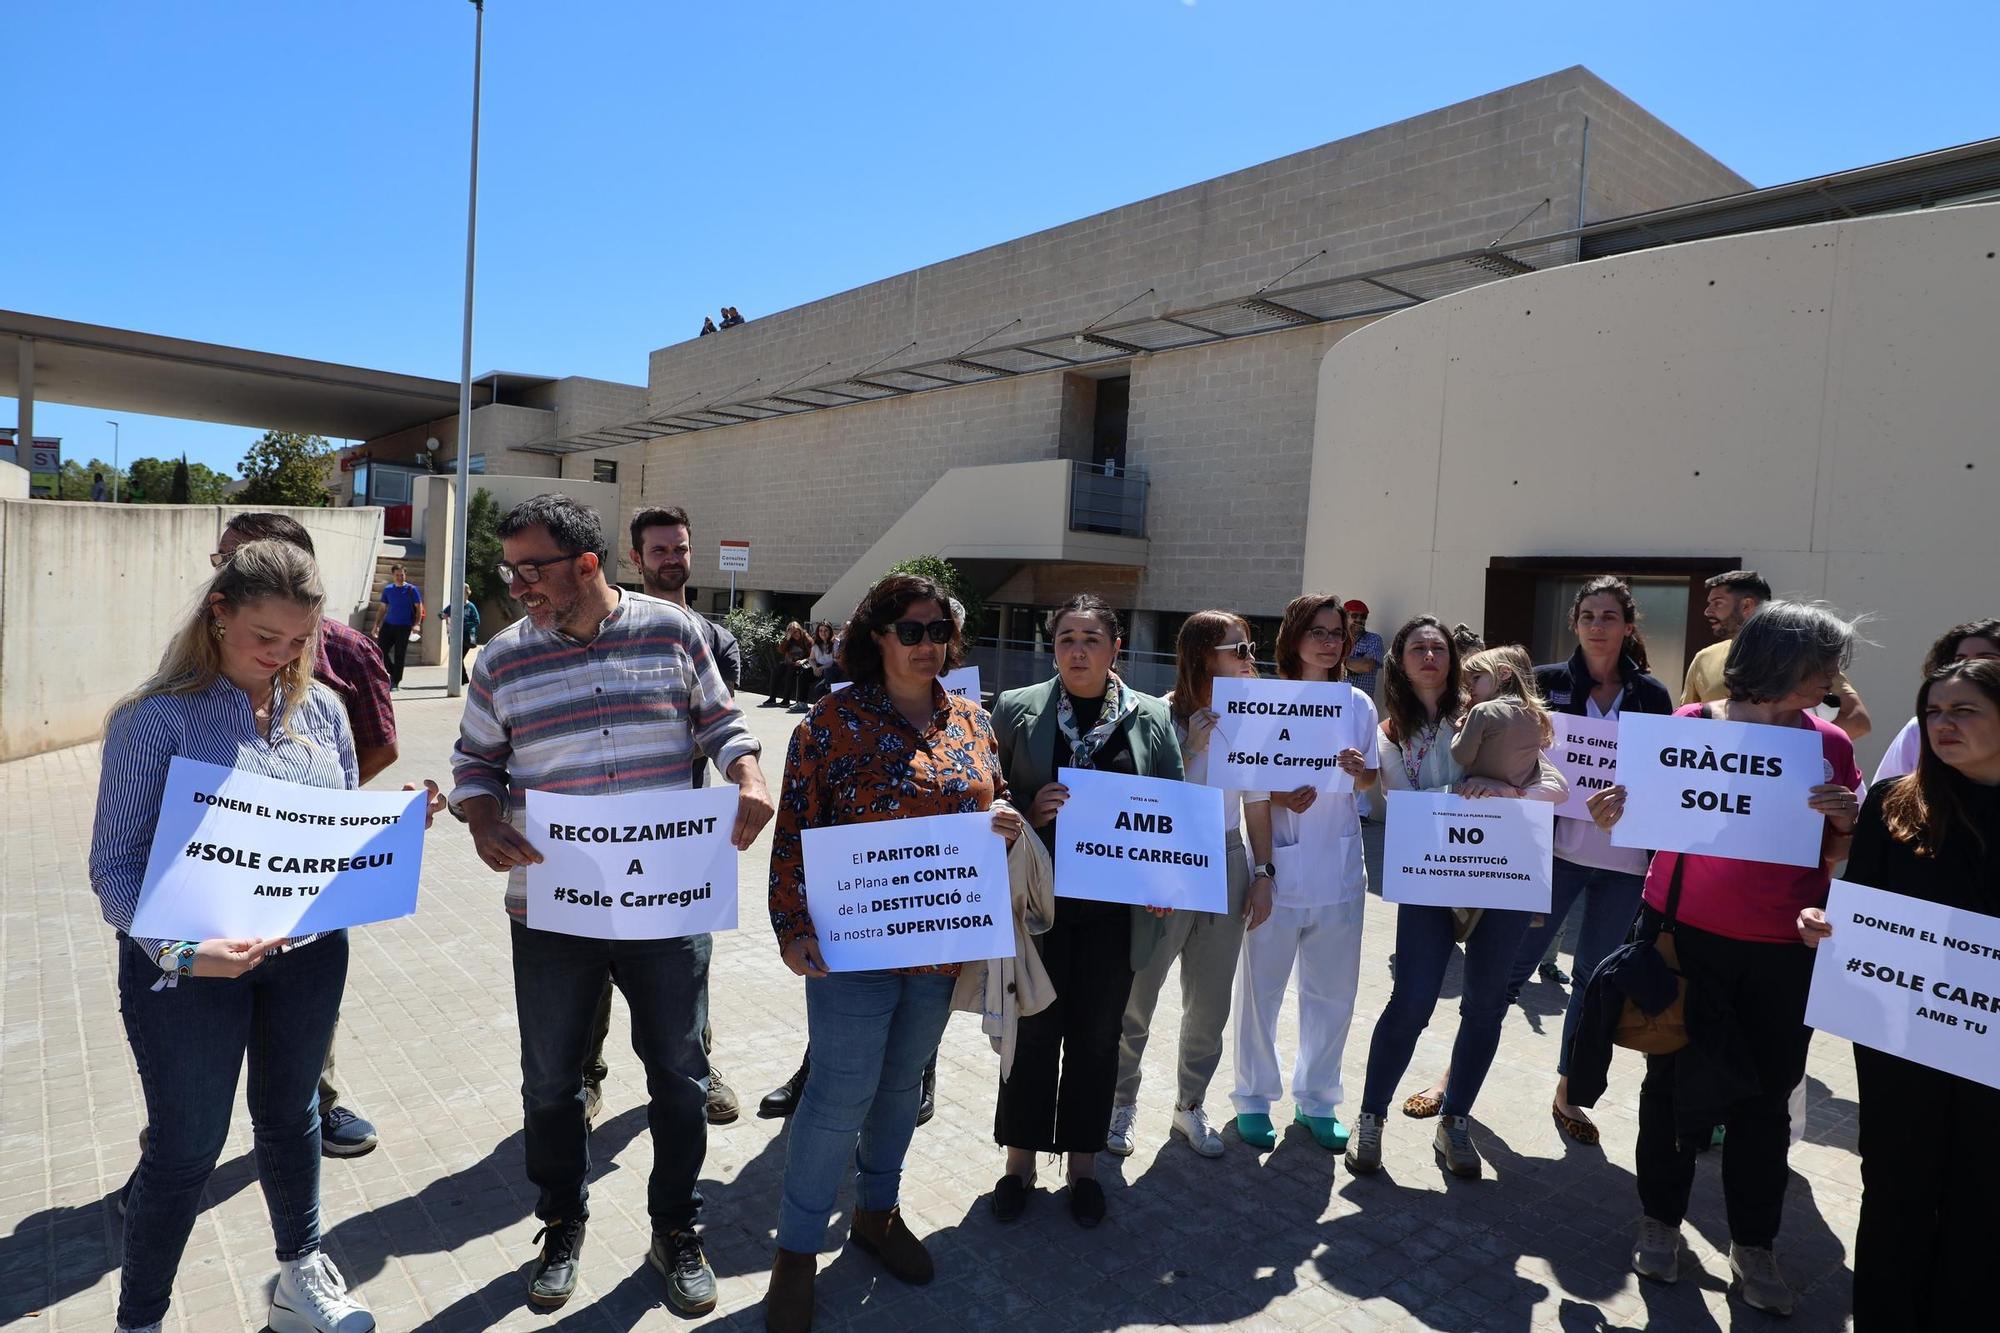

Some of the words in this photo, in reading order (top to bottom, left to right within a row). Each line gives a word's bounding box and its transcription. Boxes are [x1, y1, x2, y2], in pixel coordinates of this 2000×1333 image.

[1228, 701, 1342, 717] RECOLZAMENT
[1279, 729, 1290, 741] A
[1567, 734, 1584, 744] ELS
[1228, 752, 1269, 765] #Sole
[1273, 753, 1337, 771] Carregui
[1567, 752, 1593, 766] DEL
[1660, 745, 1782, 777] GRÀCIES
[193, 792, 252, 813] DONEM
[256, 806, 271, 817] EL
[276, 810, 335, 825] NOSTRE
[340, 816, 400, 827] SUPORT
[1681, 789, 1751, 815] SOLE
[550, 817, 717, 843] RECOLZAMENT
[1114, 811, 1173, 834] AMB
[1449, 827, 1484, 844] NO
[186, 841, 261, 869] #SOLE
[268, 852, 393, 873] CARREGUI
[853, 853, 863, 864] El
[867, 845, 939, 863] PARITORI
[944, 844, 958, 855] de
[1076, 842, 1123, 858] #SOLE
[1128, 848, 1208, 868] CARREGUI
[1450, 856, 1507, 865] DESTITUCIÓ
[627, 859, 643, 875] A
[838, 880, 850, 890] La
[855, 877, 888, 889] Plana
[892, 876, 909, 885] en
[914, 866, 978, 882] CONTRA
[1430, 869, 1465, 877] NOSTRA
[1468, 871, 1530, 881] SUPERVISORA
[254, 885, 292, 896] AMB
[298, 886, 319, 896] TU
[554, 887, 613, 907] #Sole
[620, 882, 711, 907] Carregui
[839, 904, 853, 915] de
[858, 903, 867, 913] la
[872, 889, 961, 912] DESTITUCIÓ
[967, 891, 981, 903] de
[830, 931, 840, 941] la
[845, 928, 883, 940] nostra
[887, 915, 993, 936] SUPERVISORA
[1853, 913, 1915, 937] DONEM
[1920, 931, 1937, 944] EL
[1847, 958, 1925, 992] #SOLE
[1916, 1007, 1958, 1026] AMB
[1964, 1020, 1987, 1034] TU
